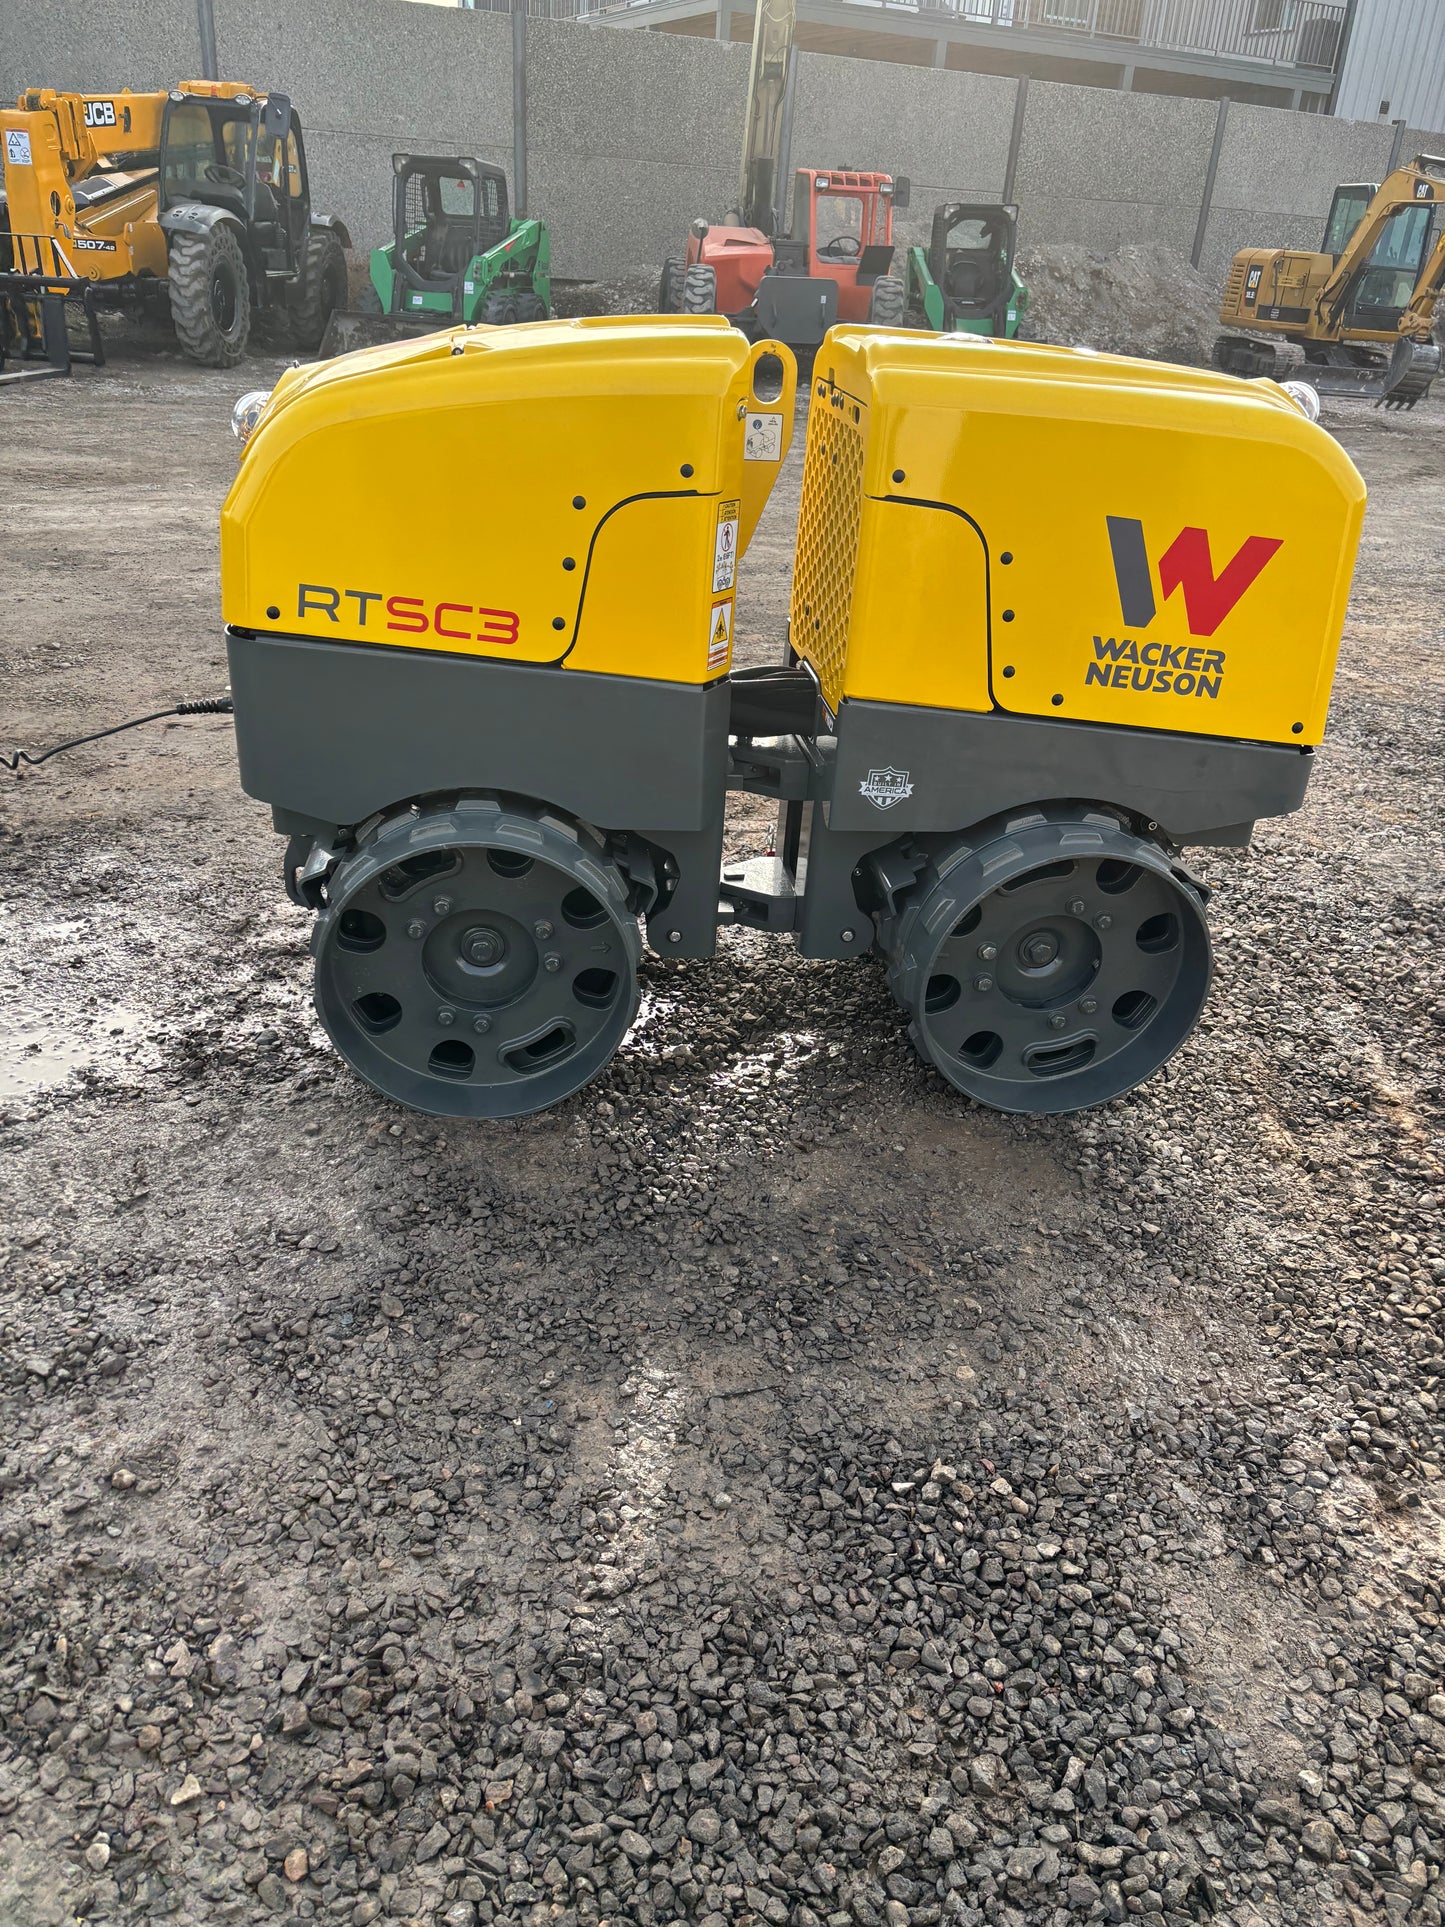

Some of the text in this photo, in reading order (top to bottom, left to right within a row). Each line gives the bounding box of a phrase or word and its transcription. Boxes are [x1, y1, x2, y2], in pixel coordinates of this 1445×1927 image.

[84, 102, 115, 126] JCB
[1416, 184, 1429, 198] CAT
[77, 240, 116, 251] 507-42
[1247, 270, 1261, 288] CAT
[297, 583, 520, 645] RTSC3
[1093, 635, 1226, 674] WACKER
[1084, 661, 1223, 699] NEUSON
[864, 786, 908, 795] AMERICA
